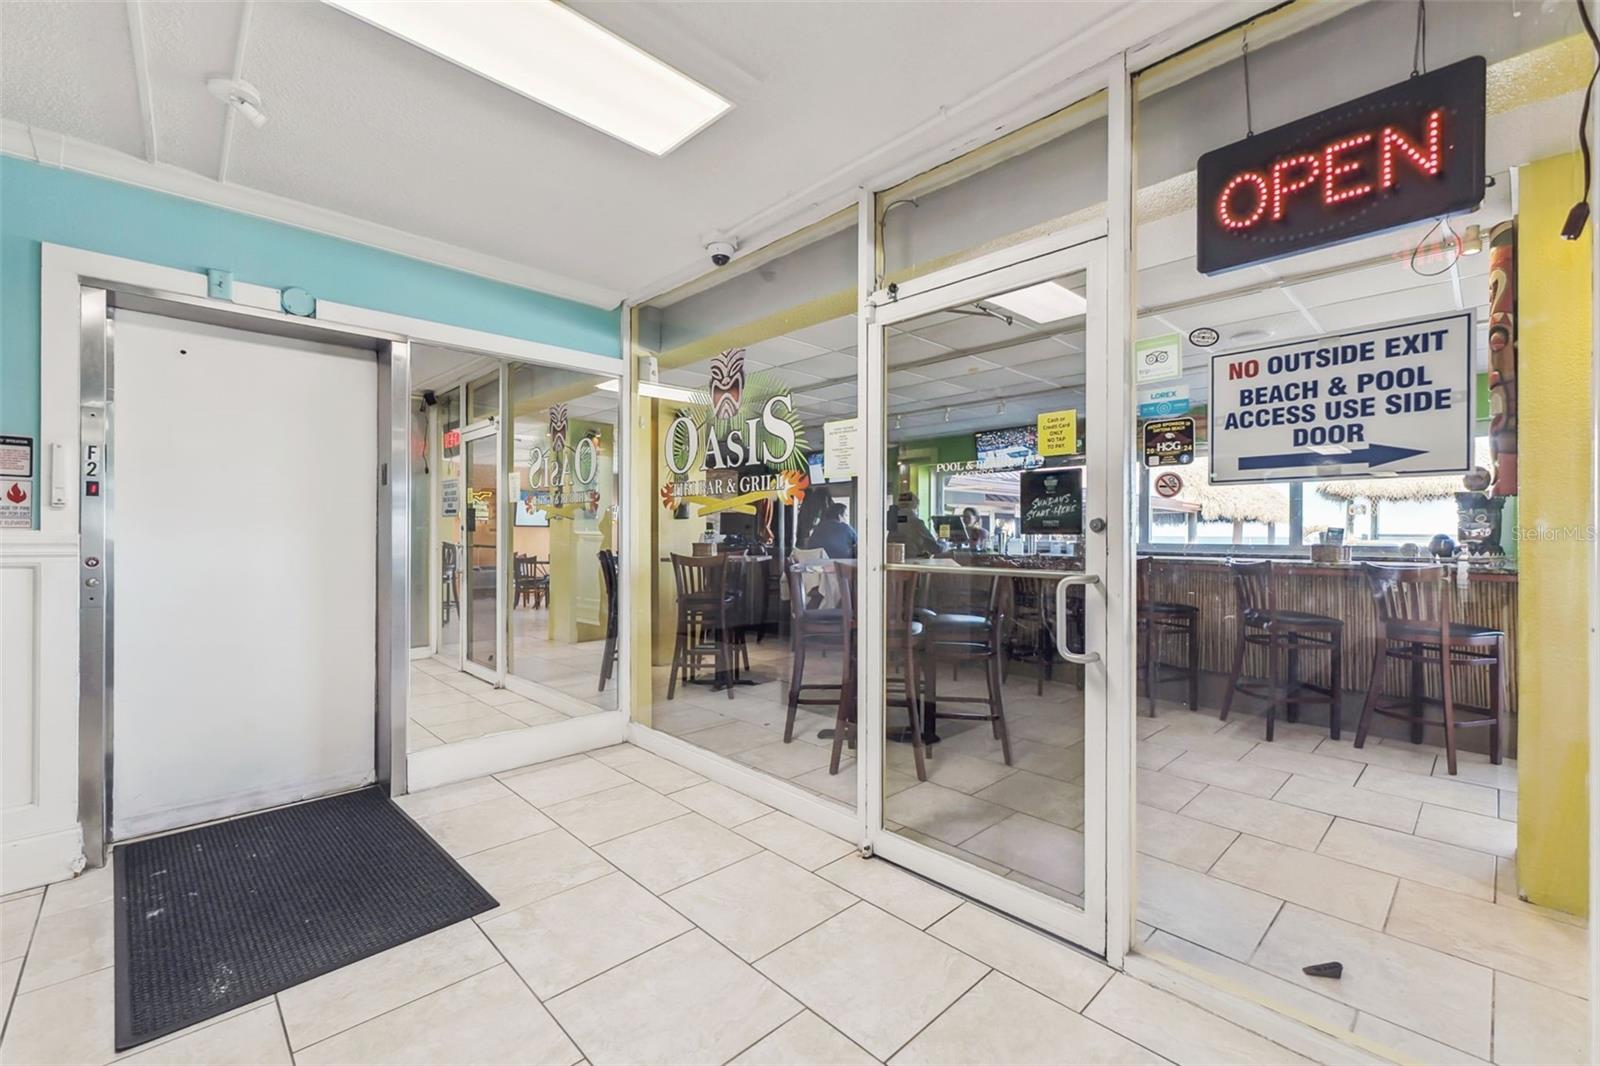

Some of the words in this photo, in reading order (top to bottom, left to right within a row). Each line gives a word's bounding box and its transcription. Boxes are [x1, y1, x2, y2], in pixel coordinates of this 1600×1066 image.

[1218, 109, 1441, 229] OPEN
[1228, 359, 1259, 380] NO
[1267, 341, 1375, 375] OUTSIDE
[1385, 329, 1449, 358] EXIT
[1150, 390, 1177, 400] LOREX
[1240, 380, 1318, 407] BEACH
[1328, 377, 1347, 397] &
[1357, 366, 1433, 393] POOL
[1224, 404, 1316, 430] ACCESS
[1325, 399, 1375, 421] USE
[1385, 388, 1451, 414] SIDE
[1293, 423, 1364, 447] DOOR
[88, 445, 97, 460] F
[1156, 441, 1181, 453] HOG
[86, 462, 97, 477] 2
[936, 462, 964, 473] POOL
[726, 478, 737, 493] &
[739, 474, 786, 493] GRILL
[1031, 493, 1072, 510] SUNDAYS
[1025, 508, 1051, 521] START
